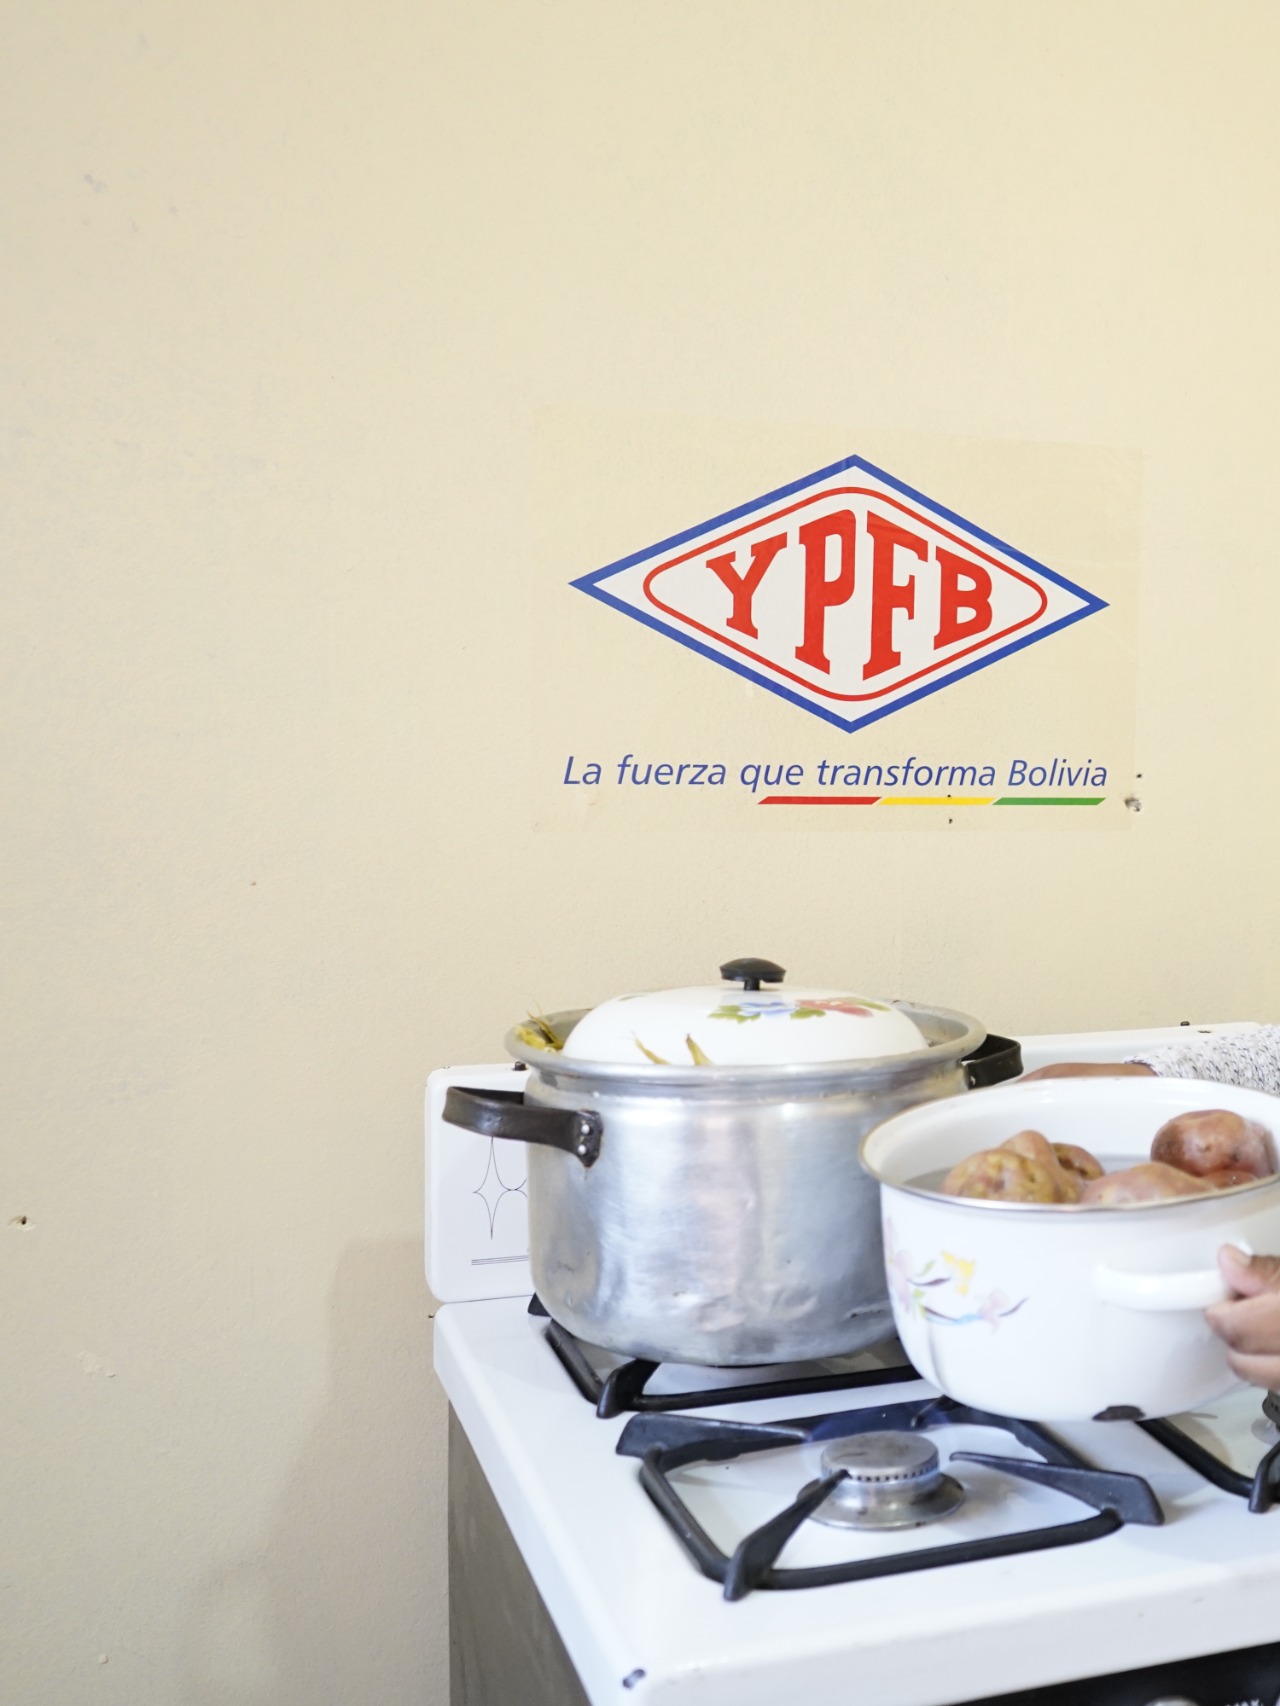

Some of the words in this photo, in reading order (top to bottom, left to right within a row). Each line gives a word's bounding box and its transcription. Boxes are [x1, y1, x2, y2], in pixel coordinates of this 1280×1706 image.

[705, 508, 994, 682] YPFB
[563, 756, 602, 785] La
[616, 754, 727, 788] fuerza
[740, 763, 805, 793] que
[817, 756, 996, 787] transforma
[1008, 758, 1108, 787] Bolivia
